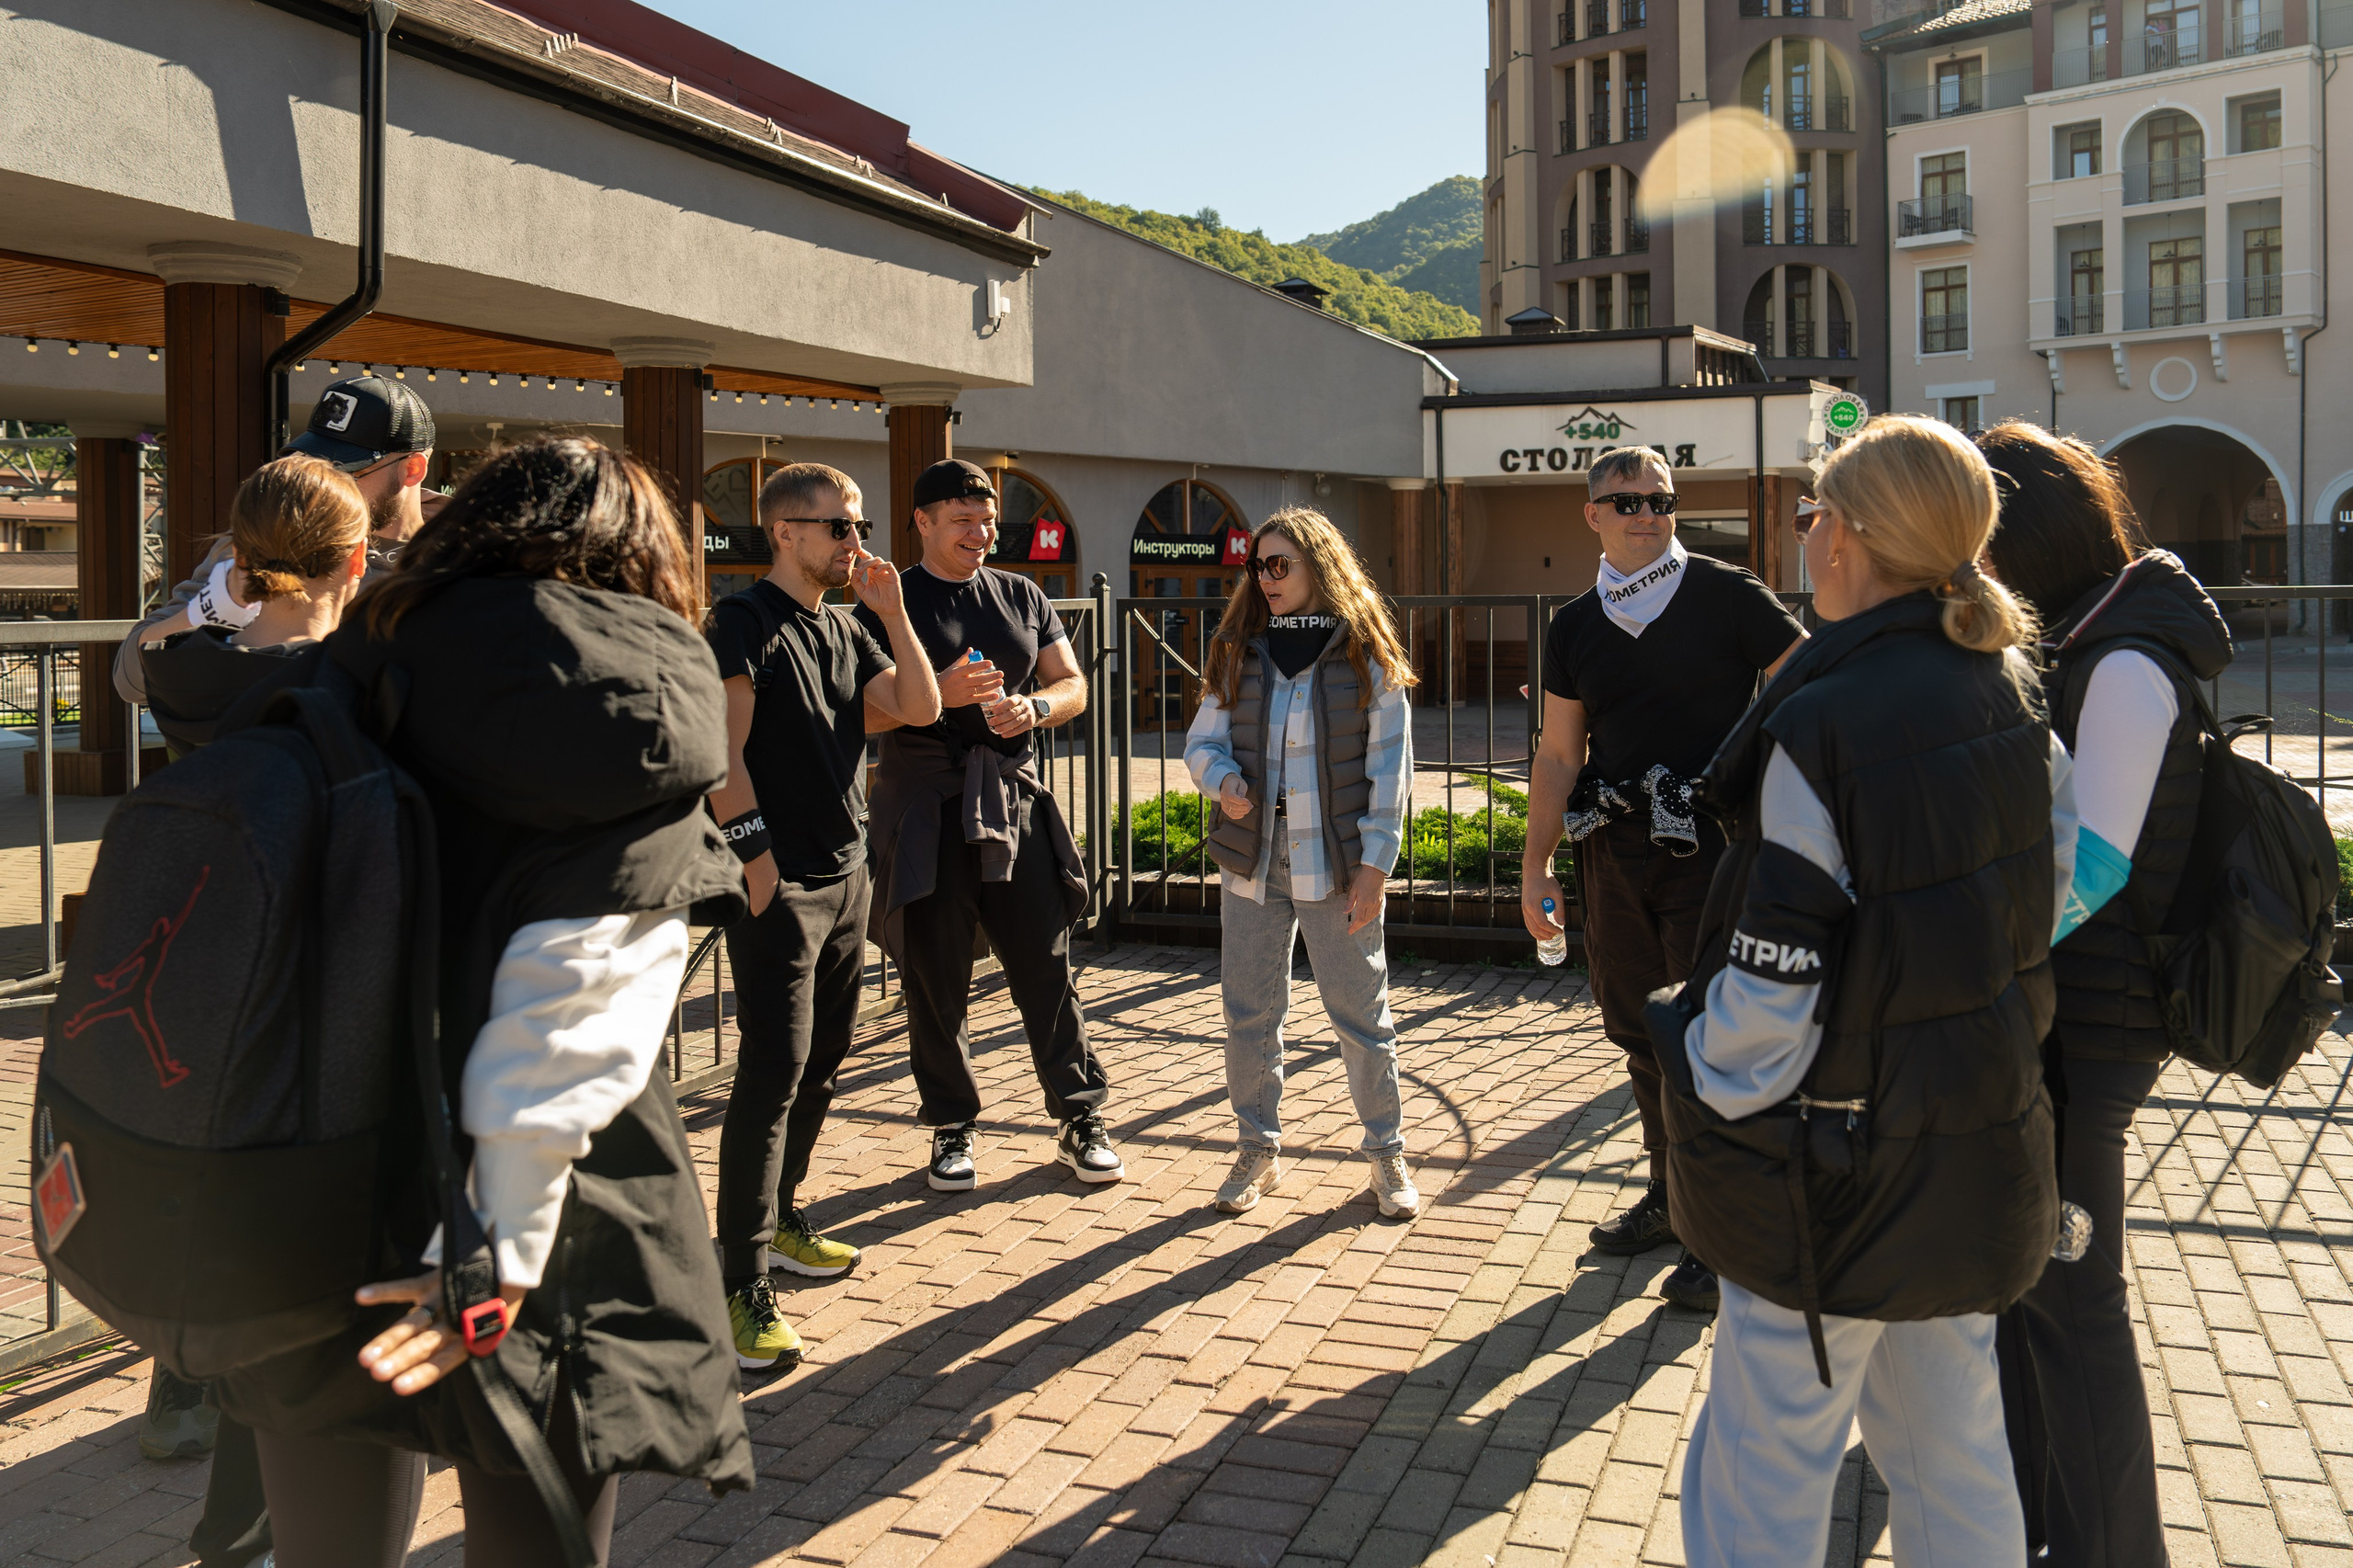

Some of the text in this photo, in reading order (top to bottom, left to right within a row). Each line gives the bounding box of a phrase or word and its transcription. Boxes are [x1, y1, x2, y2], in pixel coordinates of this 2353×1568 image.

[1564, 423, 1620, 440] +540
[1824, 419, 1863, 434] READY FOOD
[1500, 444, 1696, 472] СТОЛАЯ
[1133, 539, 1215, 559] Инструкторы
[1604, 558, 1681, 603] ОМЕТРИЯ
